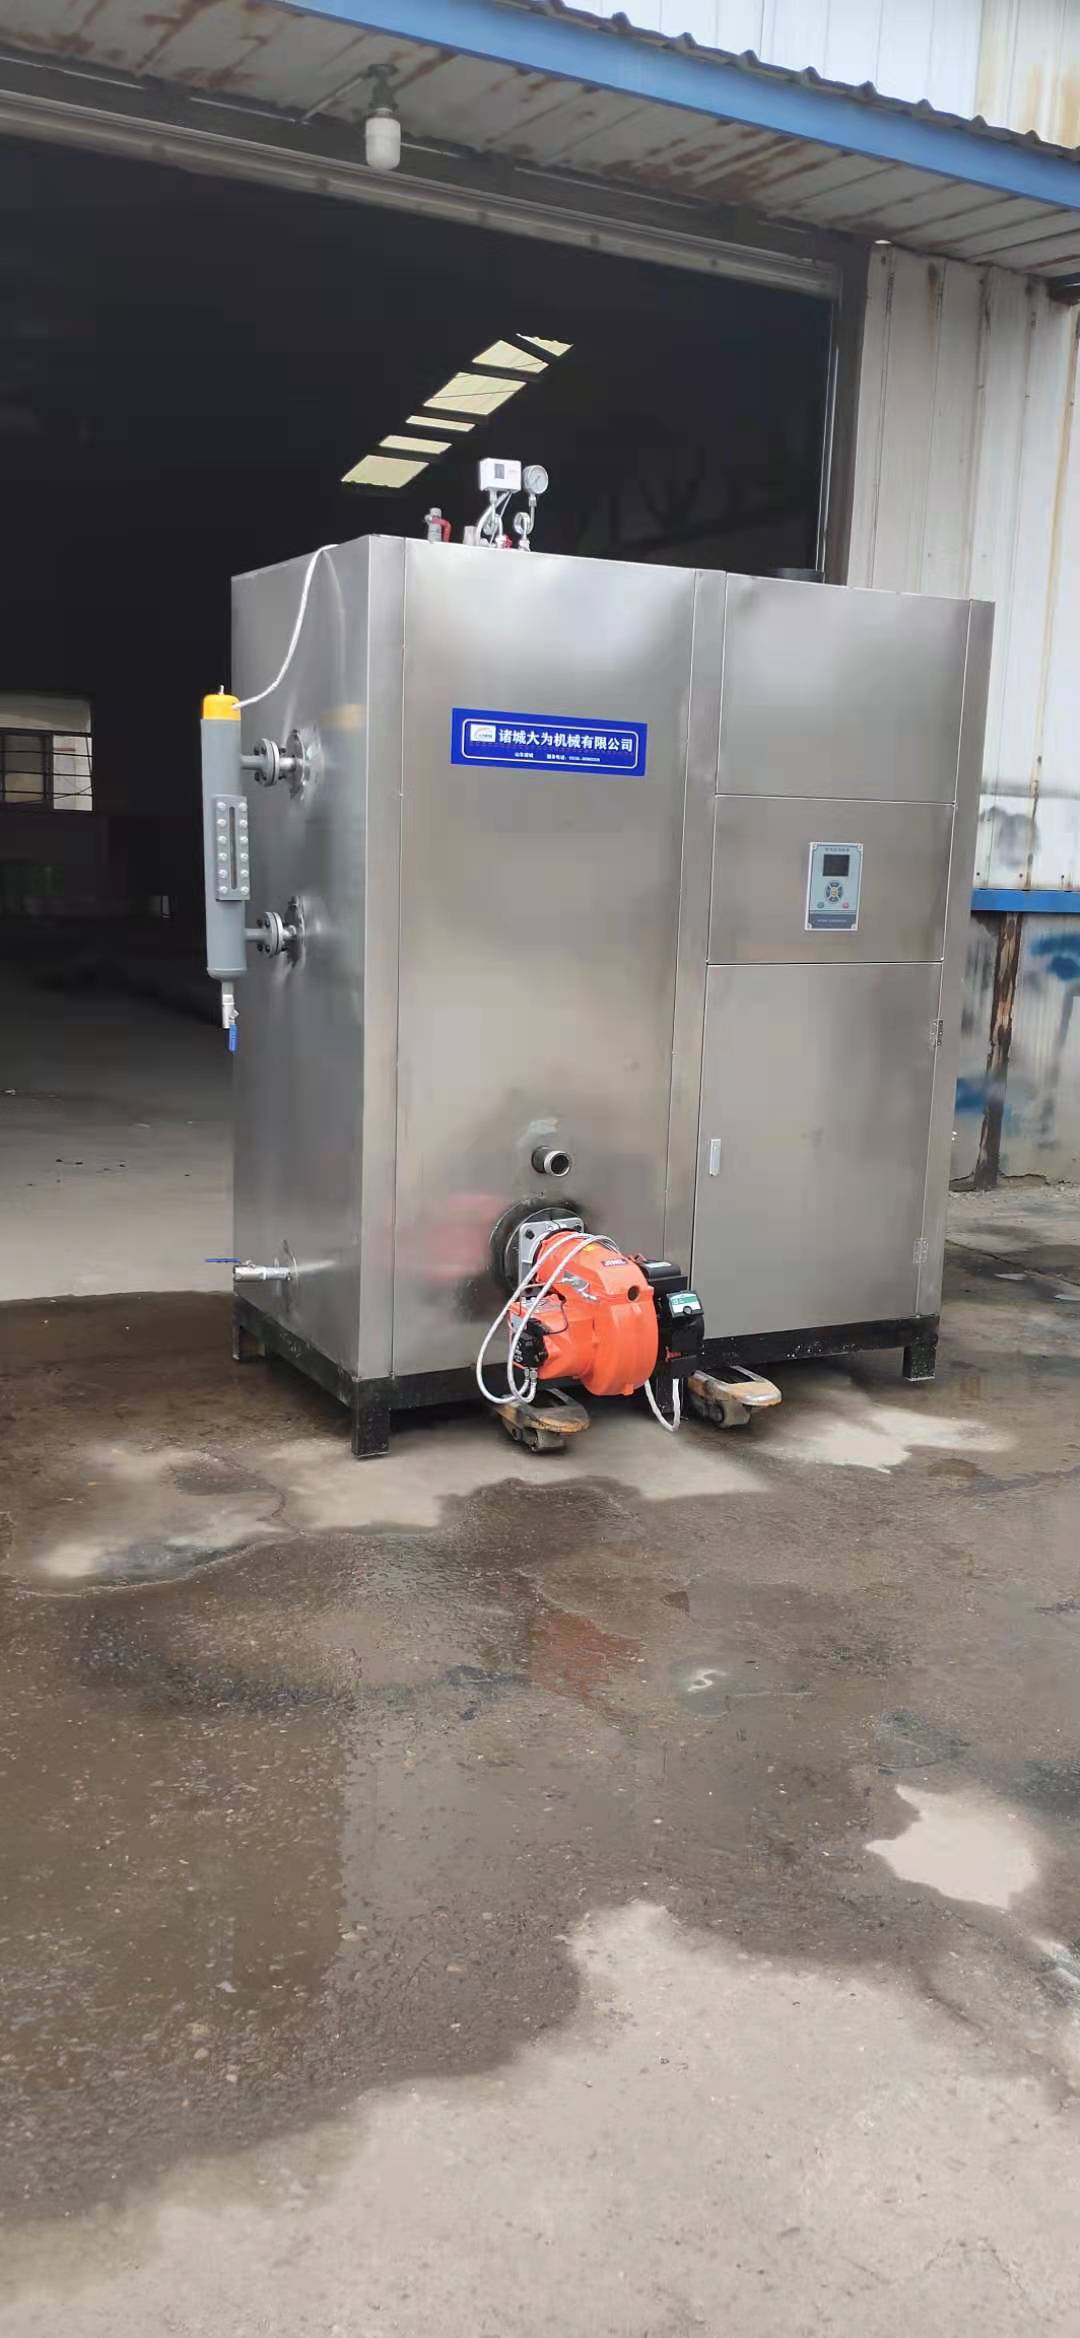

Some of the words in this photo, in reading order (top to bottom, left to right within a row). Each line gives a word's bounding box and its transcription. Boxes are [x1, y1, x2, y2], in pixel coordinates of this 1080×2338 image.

[498, 729, 633, 752] 诸城大为机械有限公司
